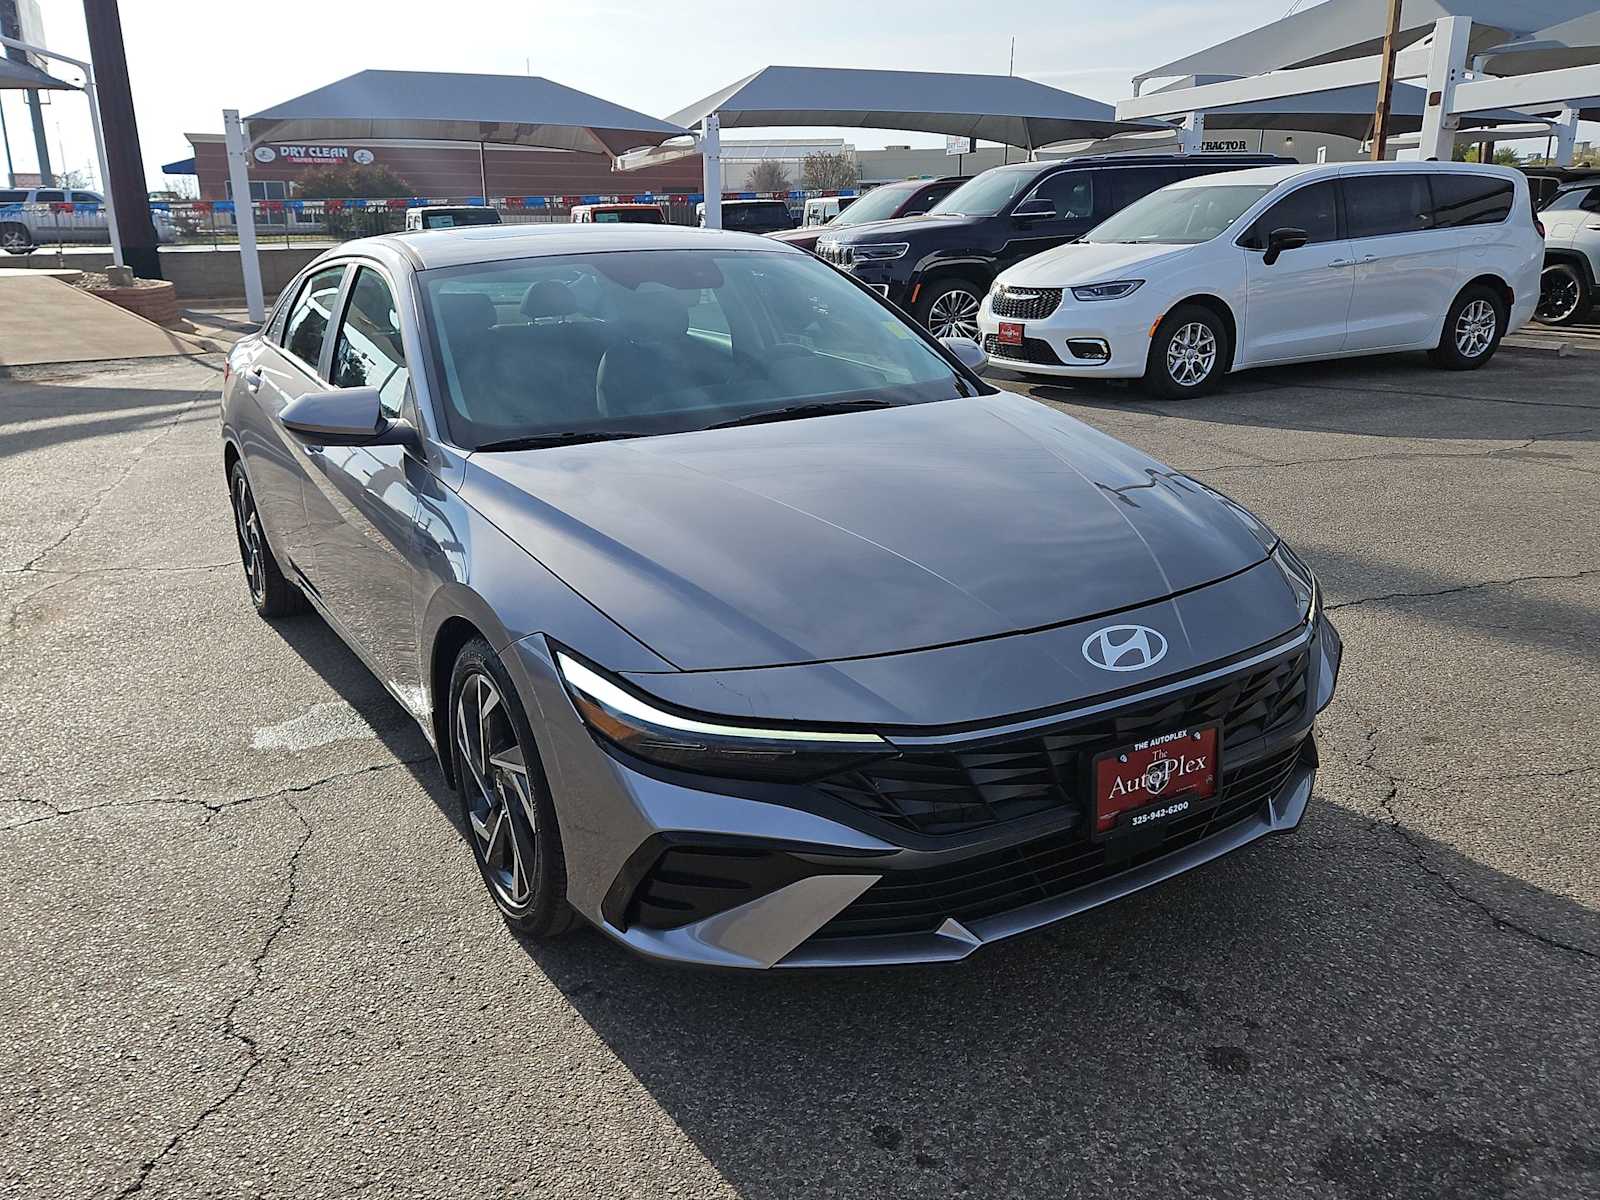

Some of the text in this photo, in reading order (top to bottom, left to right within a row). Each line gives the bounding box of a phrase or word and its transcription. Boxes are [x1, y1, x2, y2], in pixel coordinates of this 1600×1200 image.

[280, 146, 348, 158] DRY CLEAN
[1200, 140, 1247, 151] TRACTOR
[1134, 729, 1188, 752] THE AUTOPLEX
[1152, 749, 1168, 761] The
[1108, 755, 1208, 800] AutoPlex
[1132, 801, 1189, 826] 325-942-6200
